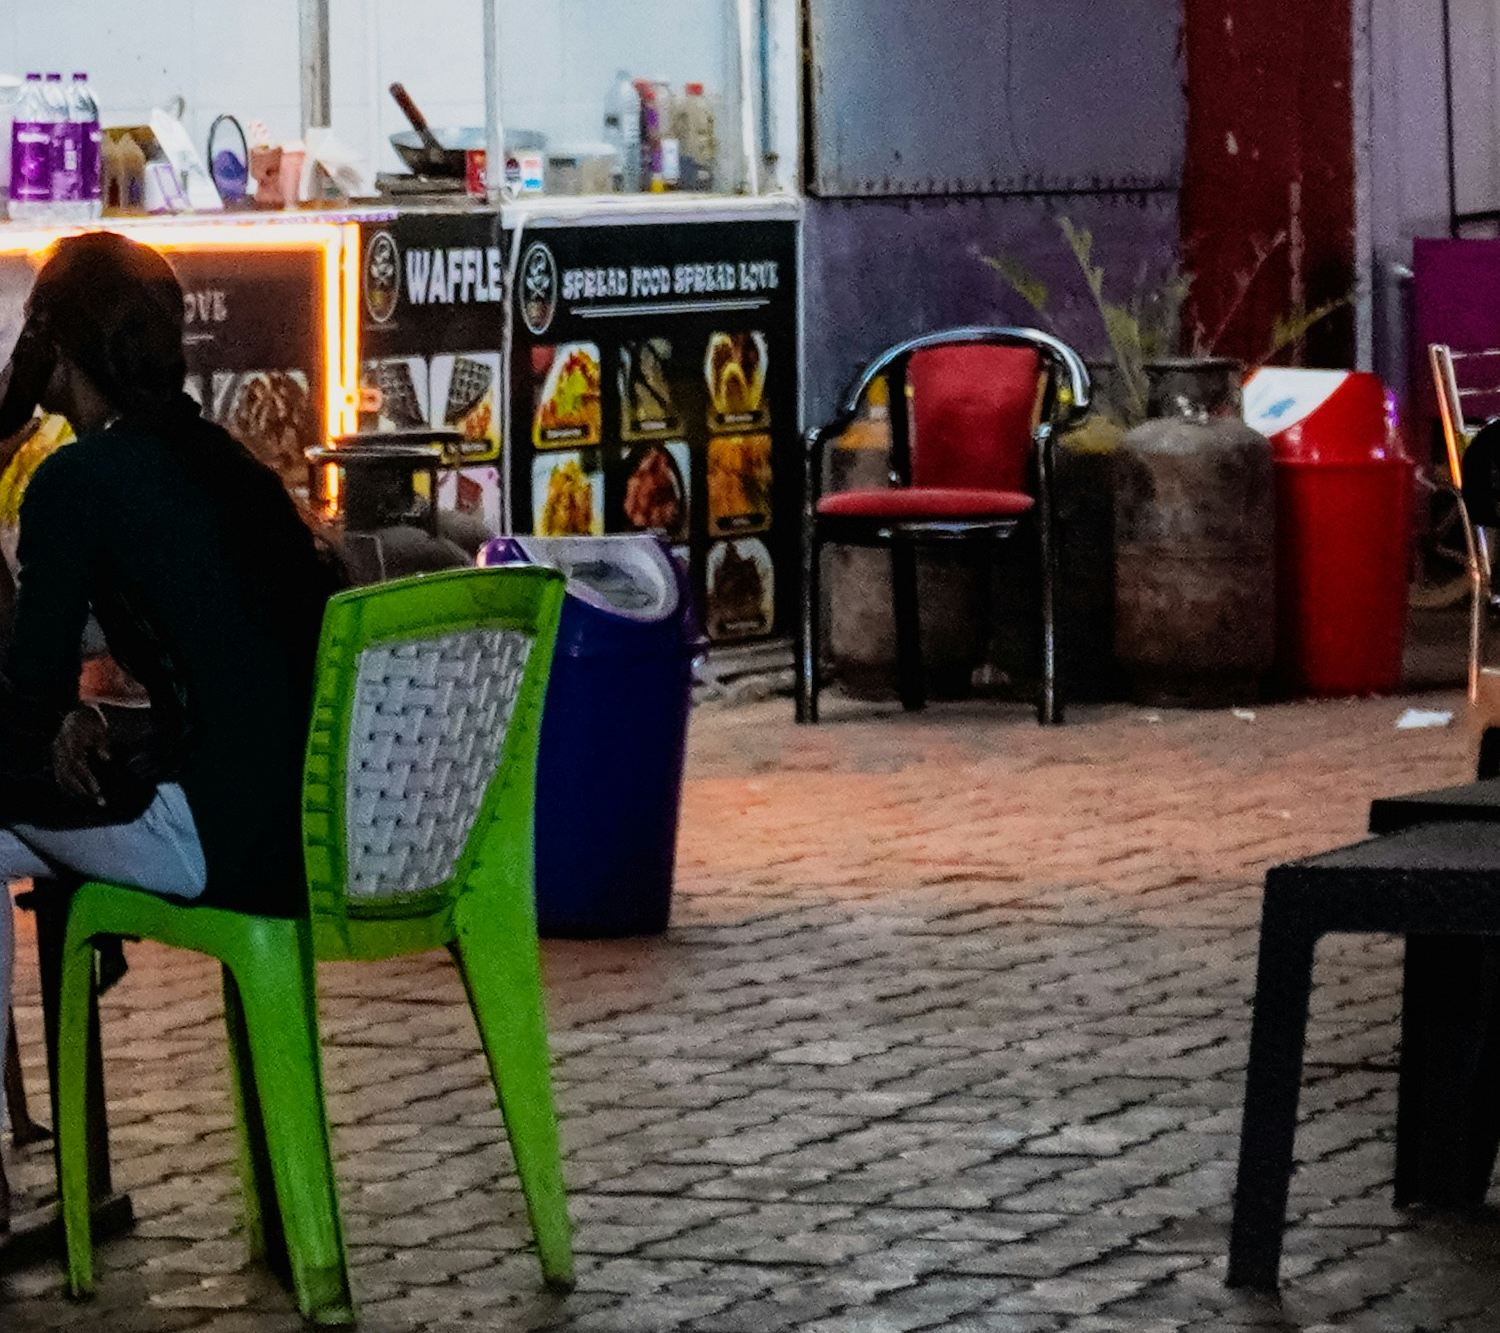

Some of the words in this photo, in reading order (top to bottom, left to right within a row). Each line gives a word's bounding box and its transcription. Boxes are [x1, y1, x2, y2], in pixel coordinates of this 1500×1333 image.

[561, 266, 629, 301] SPREAD
[630, 265, 672, 298] FOOD
[672, 262, 737, 295] SPREAD
[738, 259, 781, 292] LOVE
[182, 289, 229, 325] OVE
